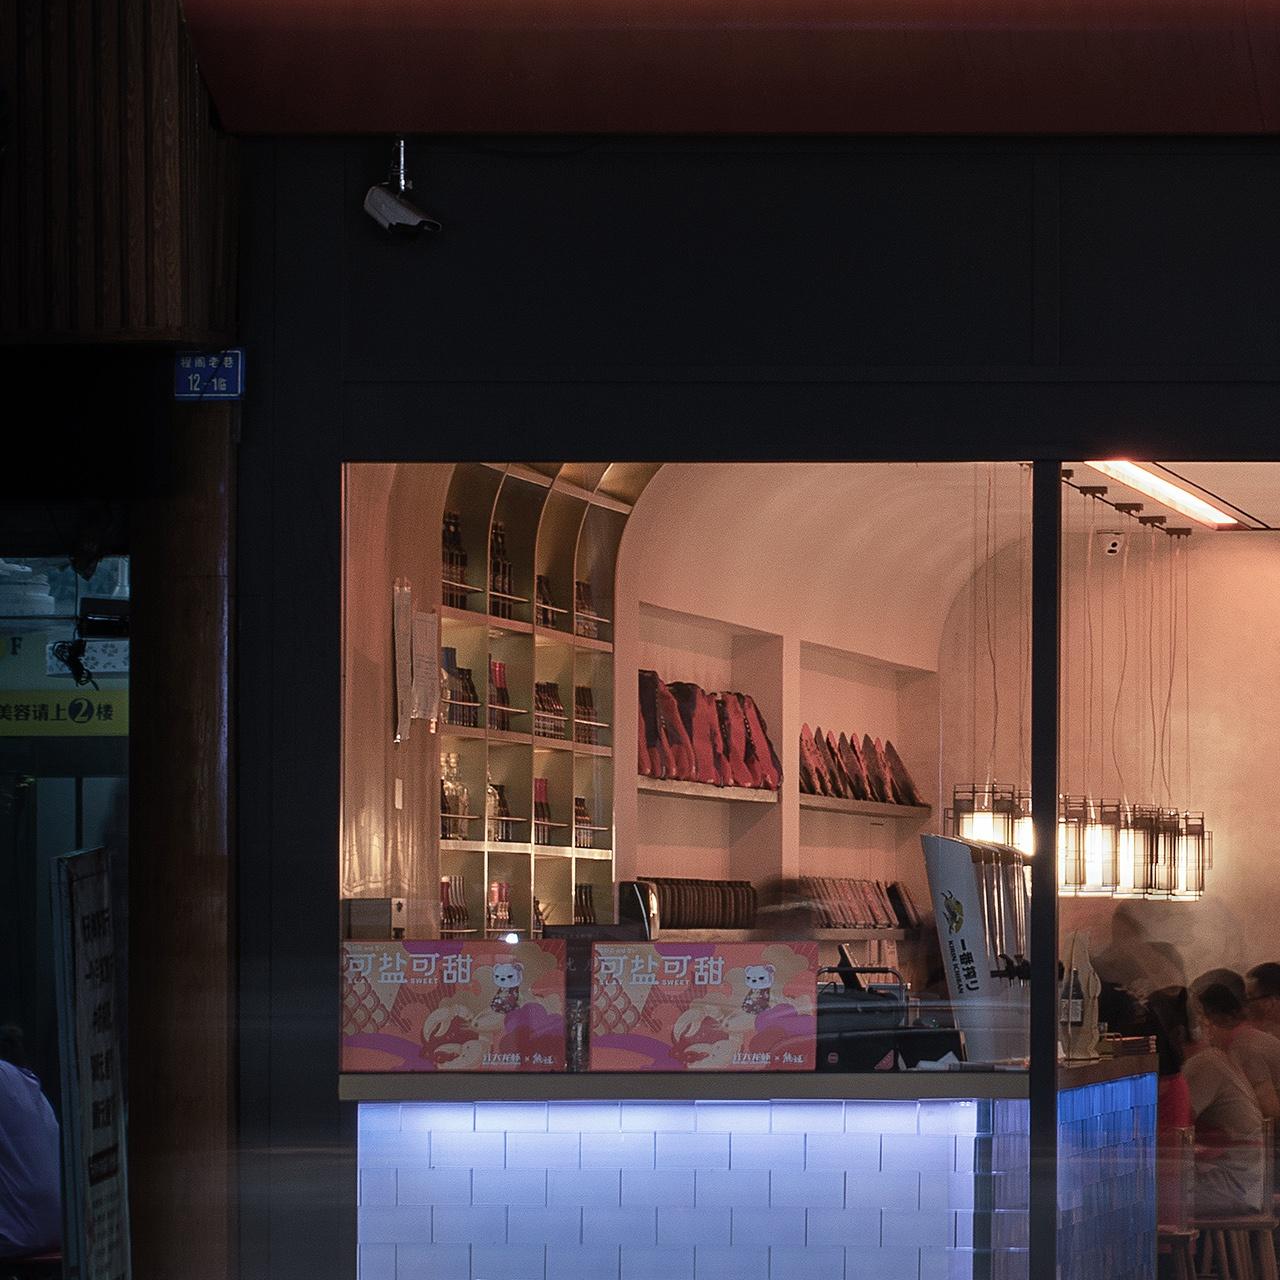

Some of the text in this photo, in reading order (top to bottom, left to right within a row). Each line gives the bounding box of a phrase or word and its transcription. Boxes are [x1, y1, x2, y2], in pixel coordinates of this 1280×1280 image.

[346, 952, 473, 984] 可盐可甜
[598, 954, 725, 986] 可盐可甜
